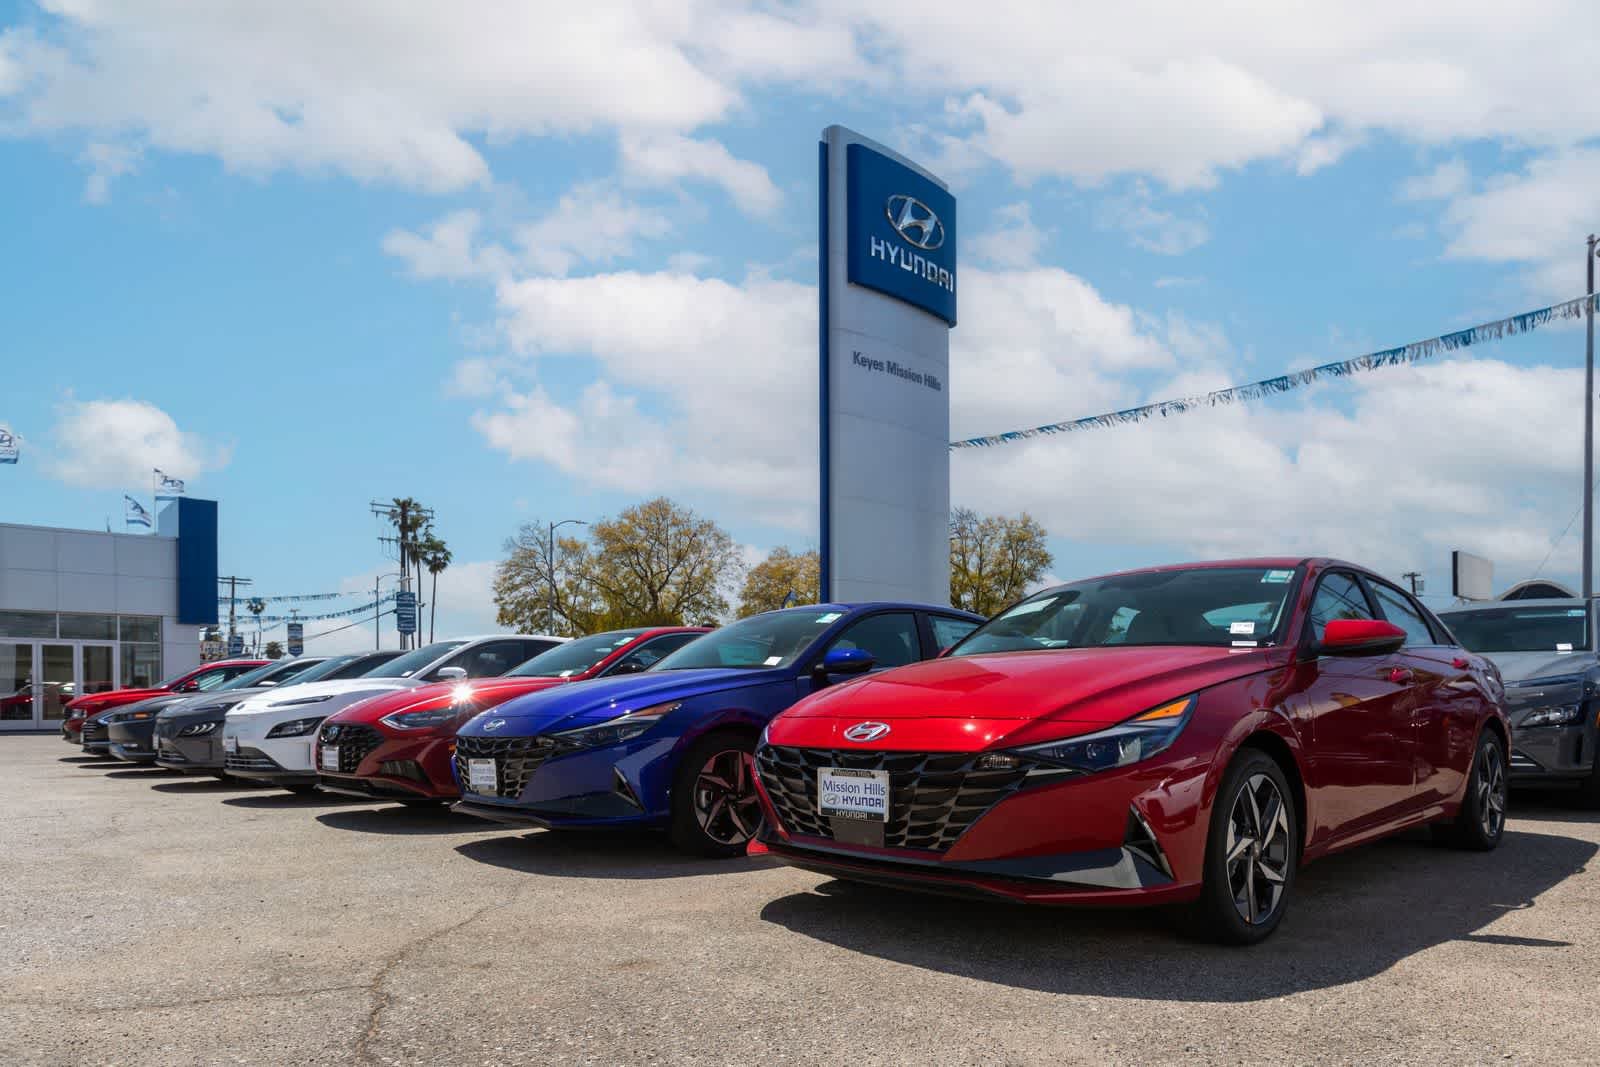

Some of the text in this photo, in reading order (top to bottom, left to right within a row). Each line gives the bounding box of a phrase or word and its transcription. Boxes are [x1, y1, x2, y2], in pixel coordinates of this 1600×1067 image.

[871, 236, 953, 292] HYUNDAI
[853, 351, 942, 391] Keyes Mission Hills
[823, 780, 885, 795] Mission Hills
[842, 796, 884, 808] HYUNDAI
[836, 810, 867, 820] HYUNDAI
